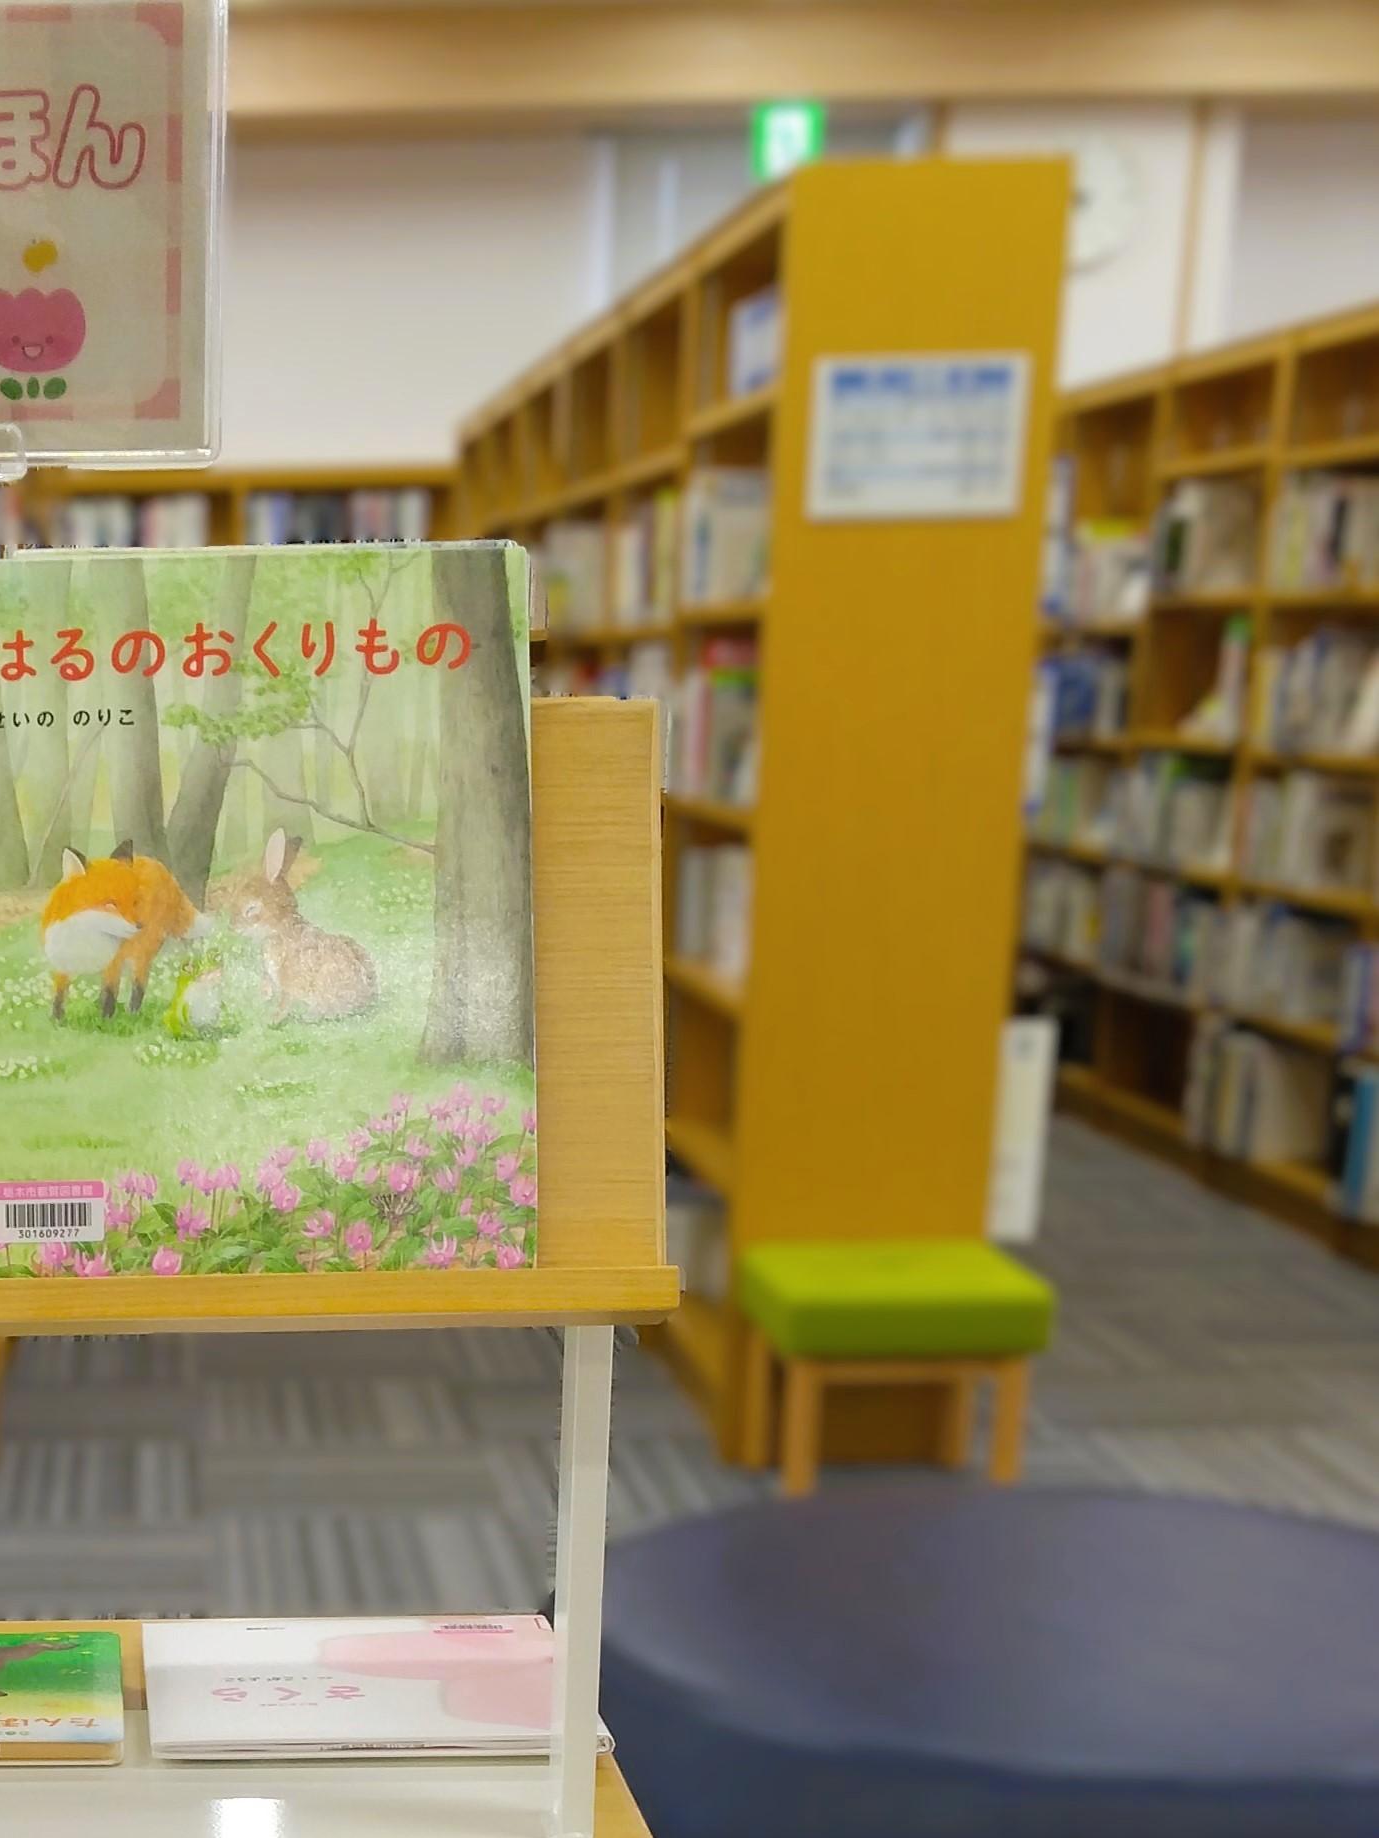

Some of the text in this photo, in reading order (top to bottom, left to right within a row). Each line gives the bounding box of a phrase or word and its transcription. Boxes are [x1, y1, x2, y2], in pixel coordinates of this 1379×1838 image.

[73, 708, 135, 727] のりこ
[18, 1228, 80, 1239] 301609277
[212, 1685, 366, 1702] さくら
